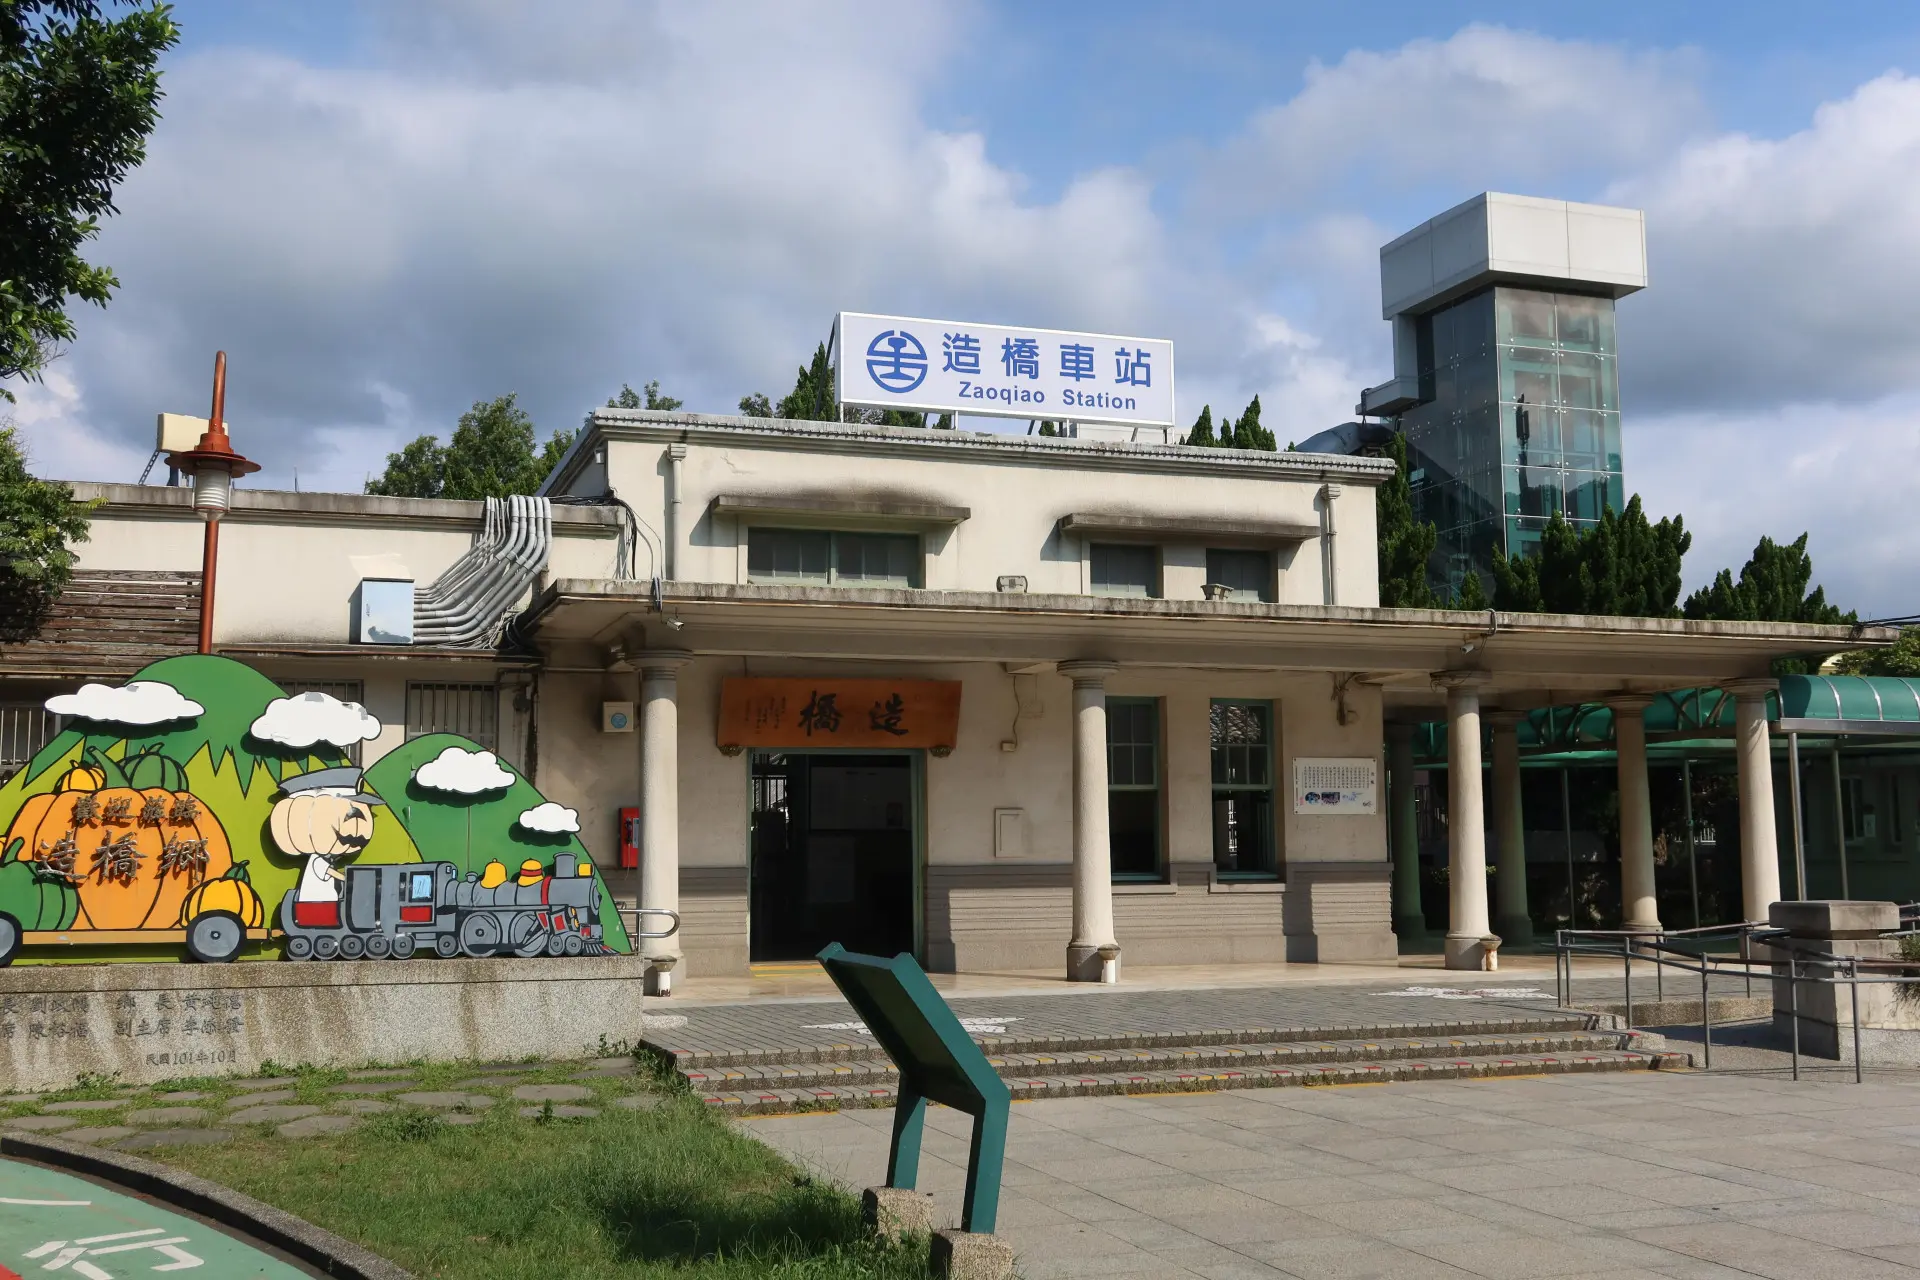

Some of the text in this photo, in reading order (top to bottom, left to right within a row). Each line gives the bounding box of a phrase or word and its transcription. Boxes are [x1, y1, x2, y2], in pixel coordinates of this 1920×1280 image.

[942, 332, 1152, 388] 造橋車站
[958, 381, 1136, 410] Zaoqiao Station
[798, 688, 909, 738] 造橋
[38, 829, 211, 884] 造橋鄉
